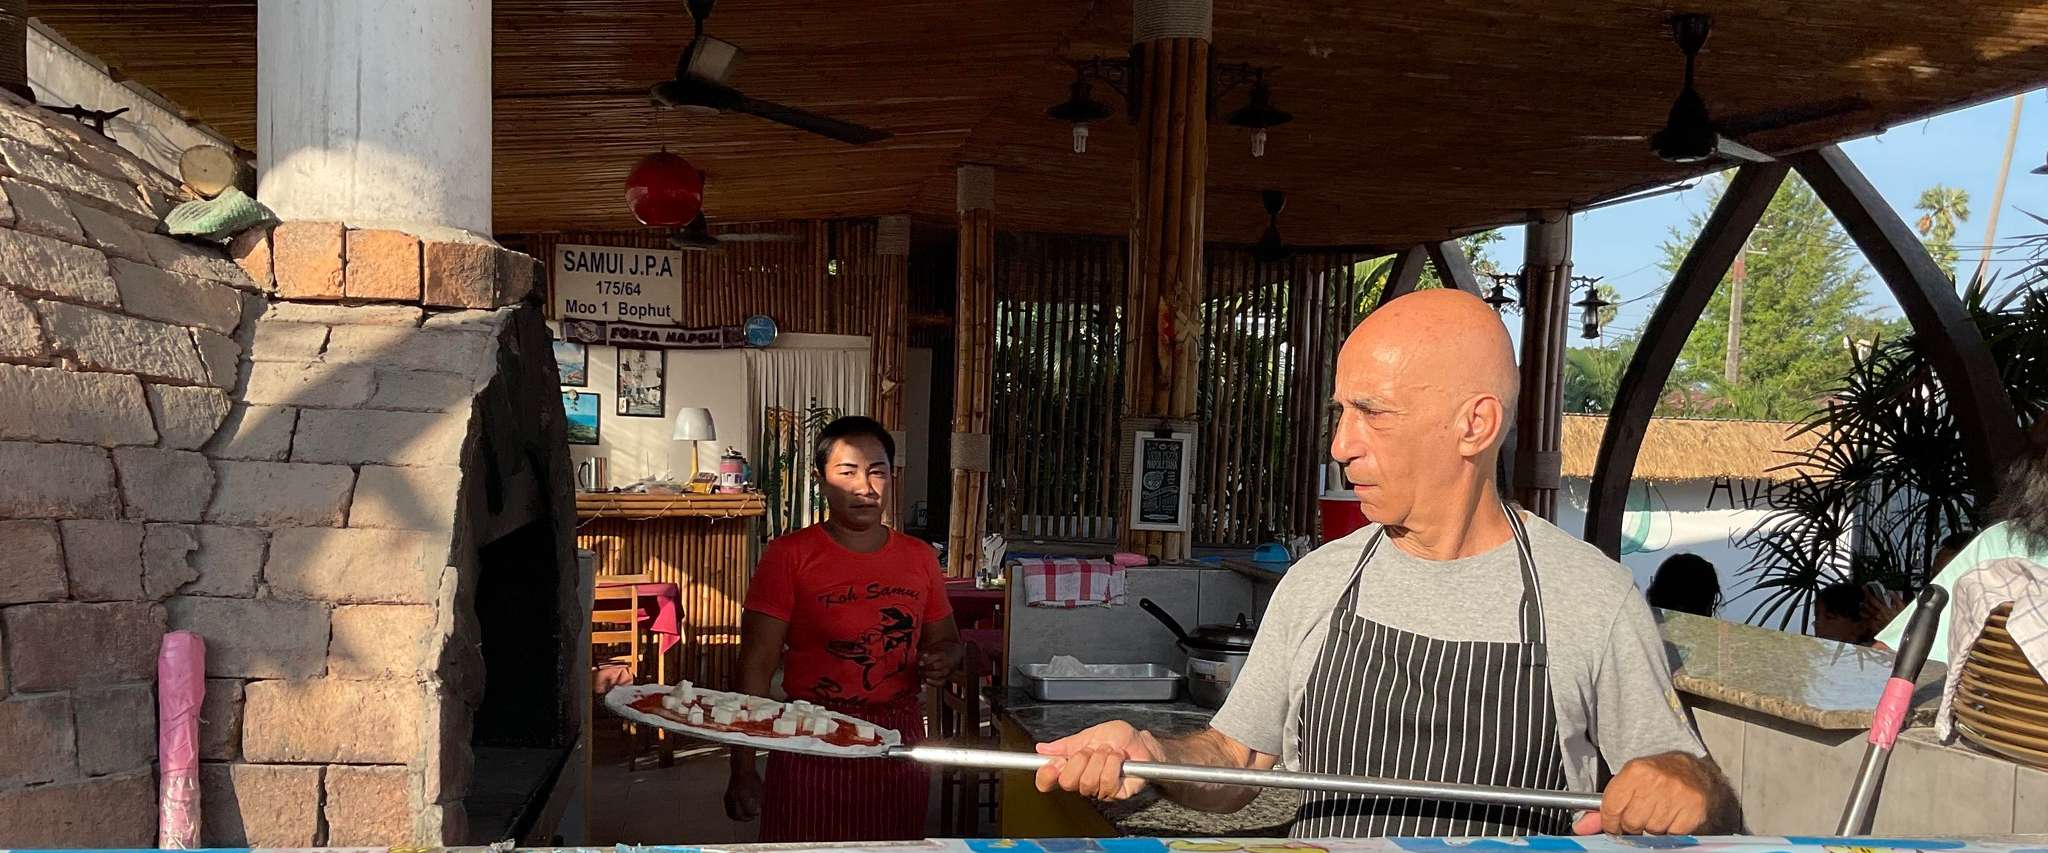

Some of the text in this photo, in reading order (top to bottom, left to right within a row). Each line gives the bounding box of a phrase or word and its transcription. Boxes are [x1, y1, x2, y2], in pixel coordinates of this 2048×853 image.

[564, 250, 673, 277] SAMUI J.P.A
[596, 281, 641, 296] 175/64
[566, 299, 671, 319] Moo 1 Bophut
[610, 327, 660, 342] FORZA
[665, 330, 720, 344] NAPOLI
[817, 581, 920, 608] Koh Samui
